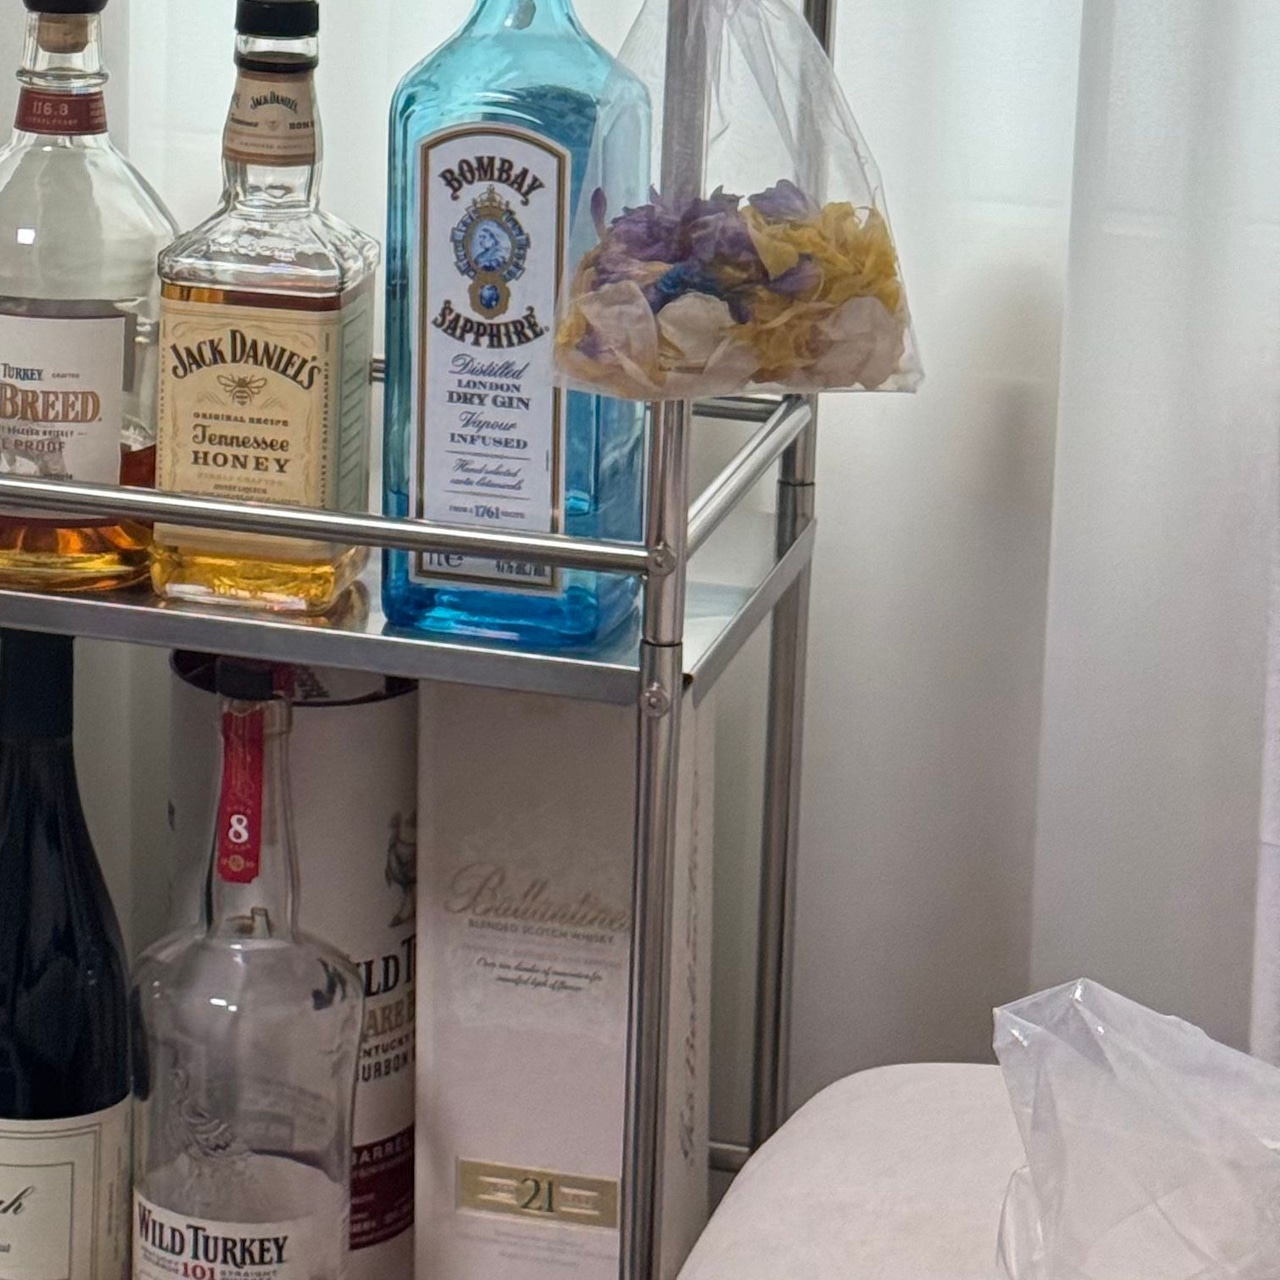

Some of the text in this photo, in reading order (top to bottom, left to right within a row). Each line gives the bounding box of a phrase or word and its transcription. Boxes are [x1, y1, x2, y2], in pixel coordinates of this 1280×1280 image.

[438, 155, 545, 206] BOMBAY
[431, 299, 546, 349] SAPPHIRE
[1, 363, 45, 381] TURKEY
[170, 328, 321, 391] JACK DANIEL'S
[448, 353, 531, 381] Distilled
[457, 379, 522, 393] LONDON
[446, 391, 532, 411] DRY GIN
[193, 411, 289, 427] ORIGINAL RECIPE
[458, 410, 518, 434] Vapour
[14, 439, 67, 454] PROOF
[191, 423, 291, 452] Tennessee
[449, 432, 529, 450] INFUSED
[191, 450, 292, 474] HONEY
[474, 504, 500, 519] 1761
[228, 814, 249, 844] 8
[443, 861, 631, 931] Ballantine
[468, 918, 615, 944] BLENDED SCOTCH WHISKY
[361, 1051, 409, 1082] URBON
[521, 1177, 554, 1213] 21
[137, 1200, 185, 1257] WILD
[186, 1223, 289, 1269] TURKEY
[182, 1262, 216, 1280] 101
